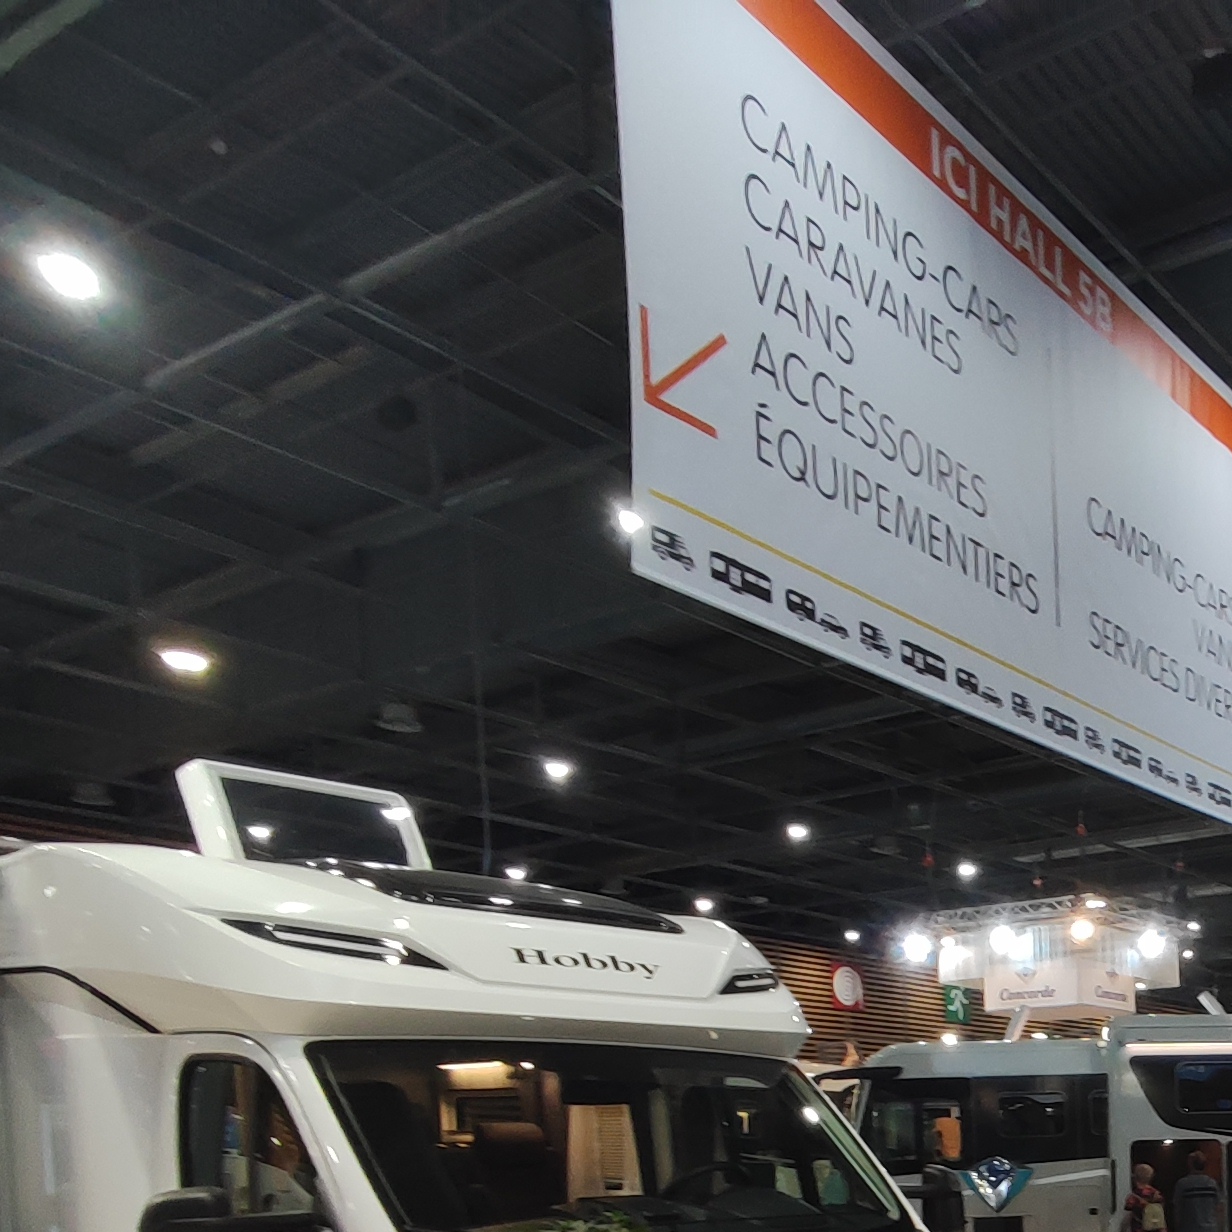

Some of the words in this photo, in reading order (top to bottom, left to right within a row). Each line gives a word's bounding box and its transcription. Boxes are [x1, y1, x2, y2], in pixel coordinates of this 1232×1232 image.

[741, 94, 1019, 357] CAMPING-CARS
[744, 173, 963, 375] CARAVANES
[930, 126, 979, 213] ICI
[989, 181, 1073, 299] HALL
[745, 246, 855, 365] VANS
[751, 332, 988, 519] ACCESSOIRES
[755, 403, 1040, 615] ÉQUIPEMENTIERS
[1089, 611, 1180, 693] SERVICES
[509, 946, 661, 979] Hobby
